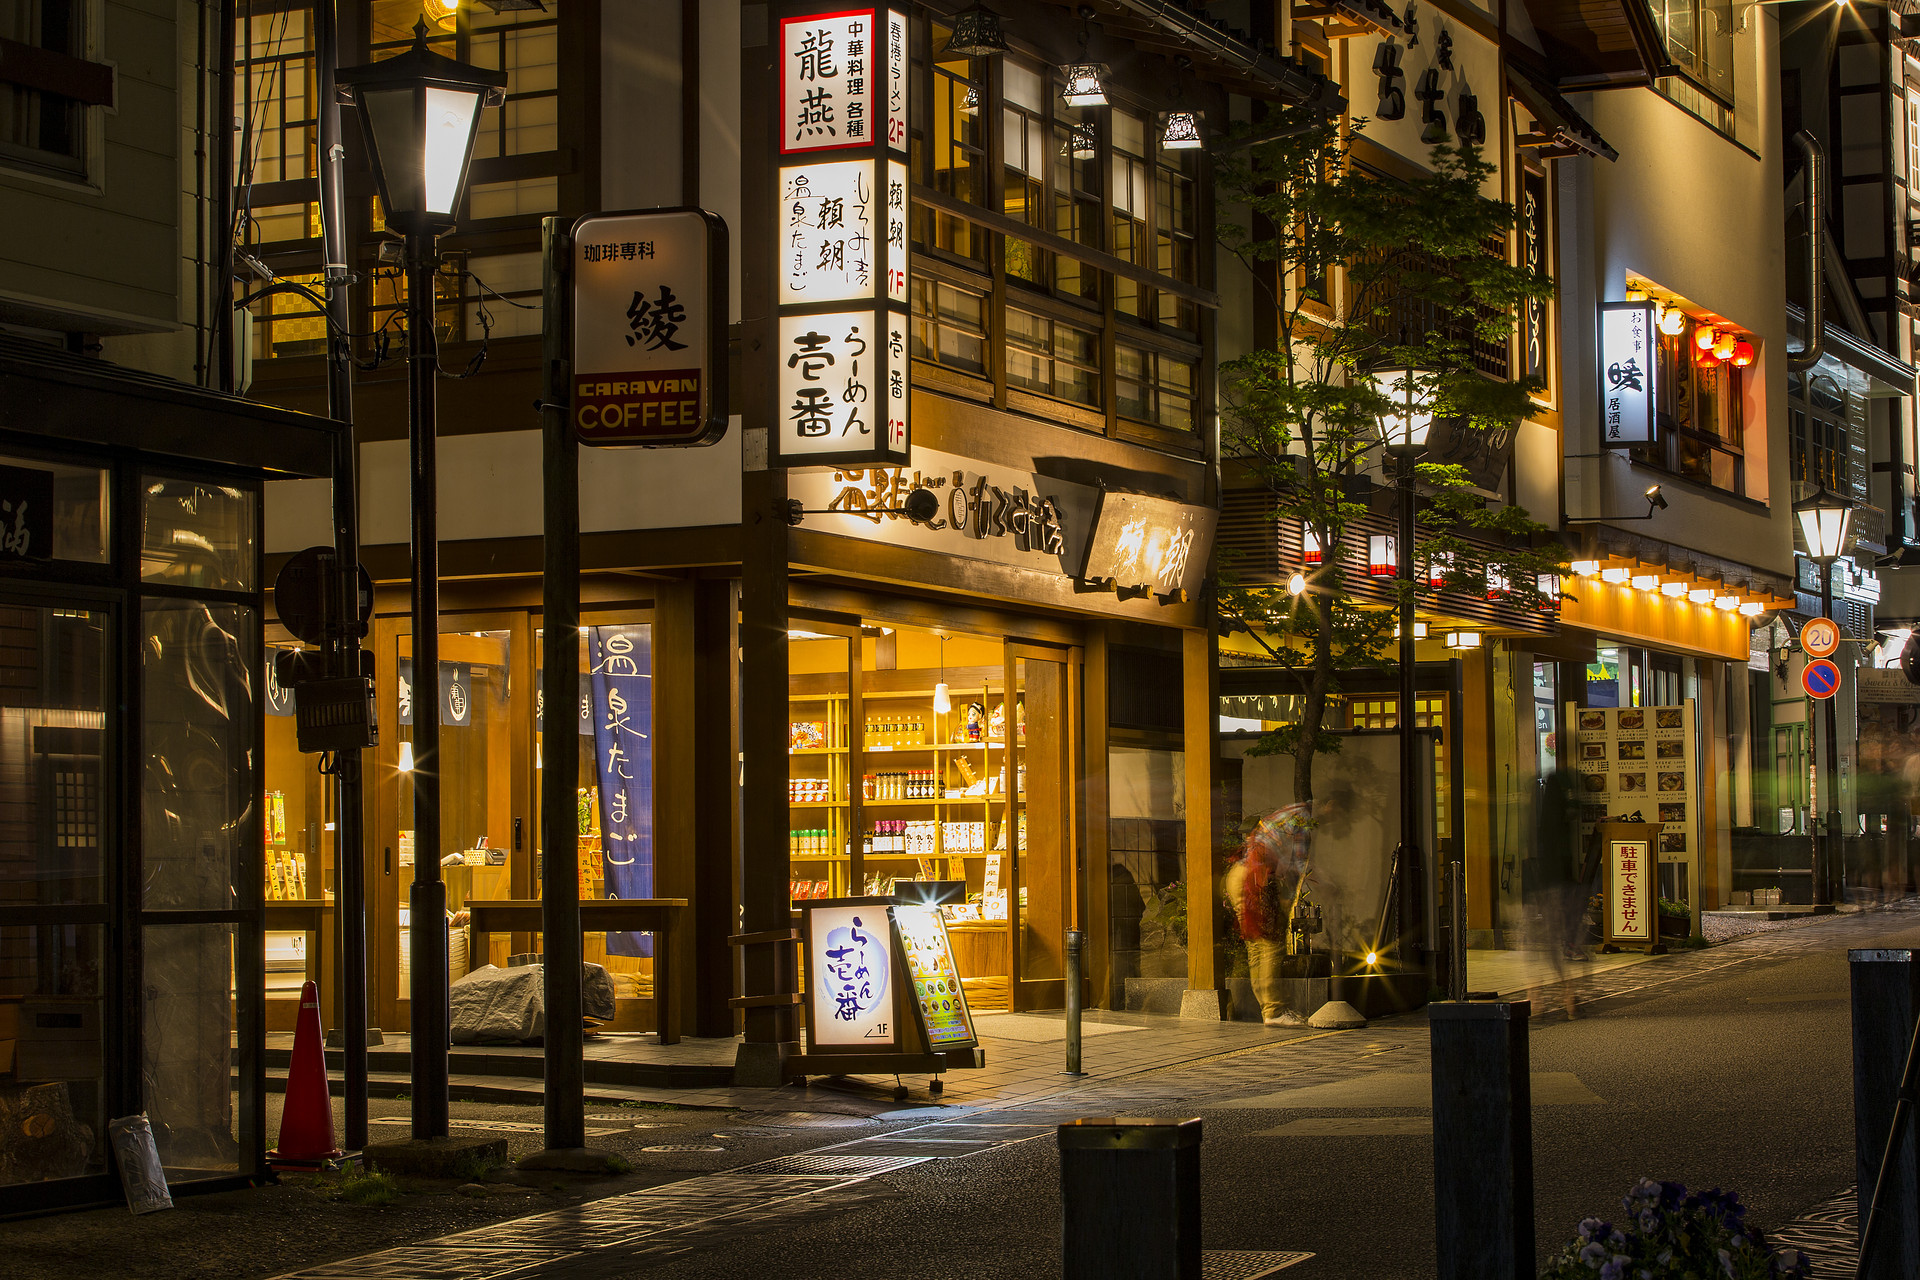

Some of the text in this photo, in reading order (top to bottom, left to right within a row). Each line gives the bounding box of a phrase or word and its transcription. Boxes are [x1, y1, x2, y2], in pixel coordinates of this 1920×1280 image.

[794, 28, 838, 141] 龍燕
[846, 21, 864, 138] 中華料理各種
[888, 117, 904, 144] 2F
[783, 175, 825, 290] 温泉たまご
[816, 197, 844, 271] 頼朝
[888, 180, 903, 250] 頼朝
[583, 241, 655, 262] 珈琲専科
[889, 268, 904, 294] 1F
[625, 285, 688, 351] 綾
[1631, 312, 1642, 353] お食事
[578, 378, 697, 397] CARAVAN
[787, 331, 835, 437] 壱番
[842, 326, 871, 437] らーめん
[889, 330, 903, 398] 壱番
[1607, 357, 1643, 392] 暖
[578, 400, 697, 429] COFFEE
[889, 418, 904, 444] 1F
[1608, 398, 1621, 439] 居酒屋
[1810, 629, 1831, 647] 20
[590, 634, 651, 866] 温泉たまご
[1620, 846, 1639, 933] 駐車できません
[825, 945, 868, 1021] 壱番
[851, 916, 873, 999] らーめん
[877, 1024, 888, 1034] 1F
